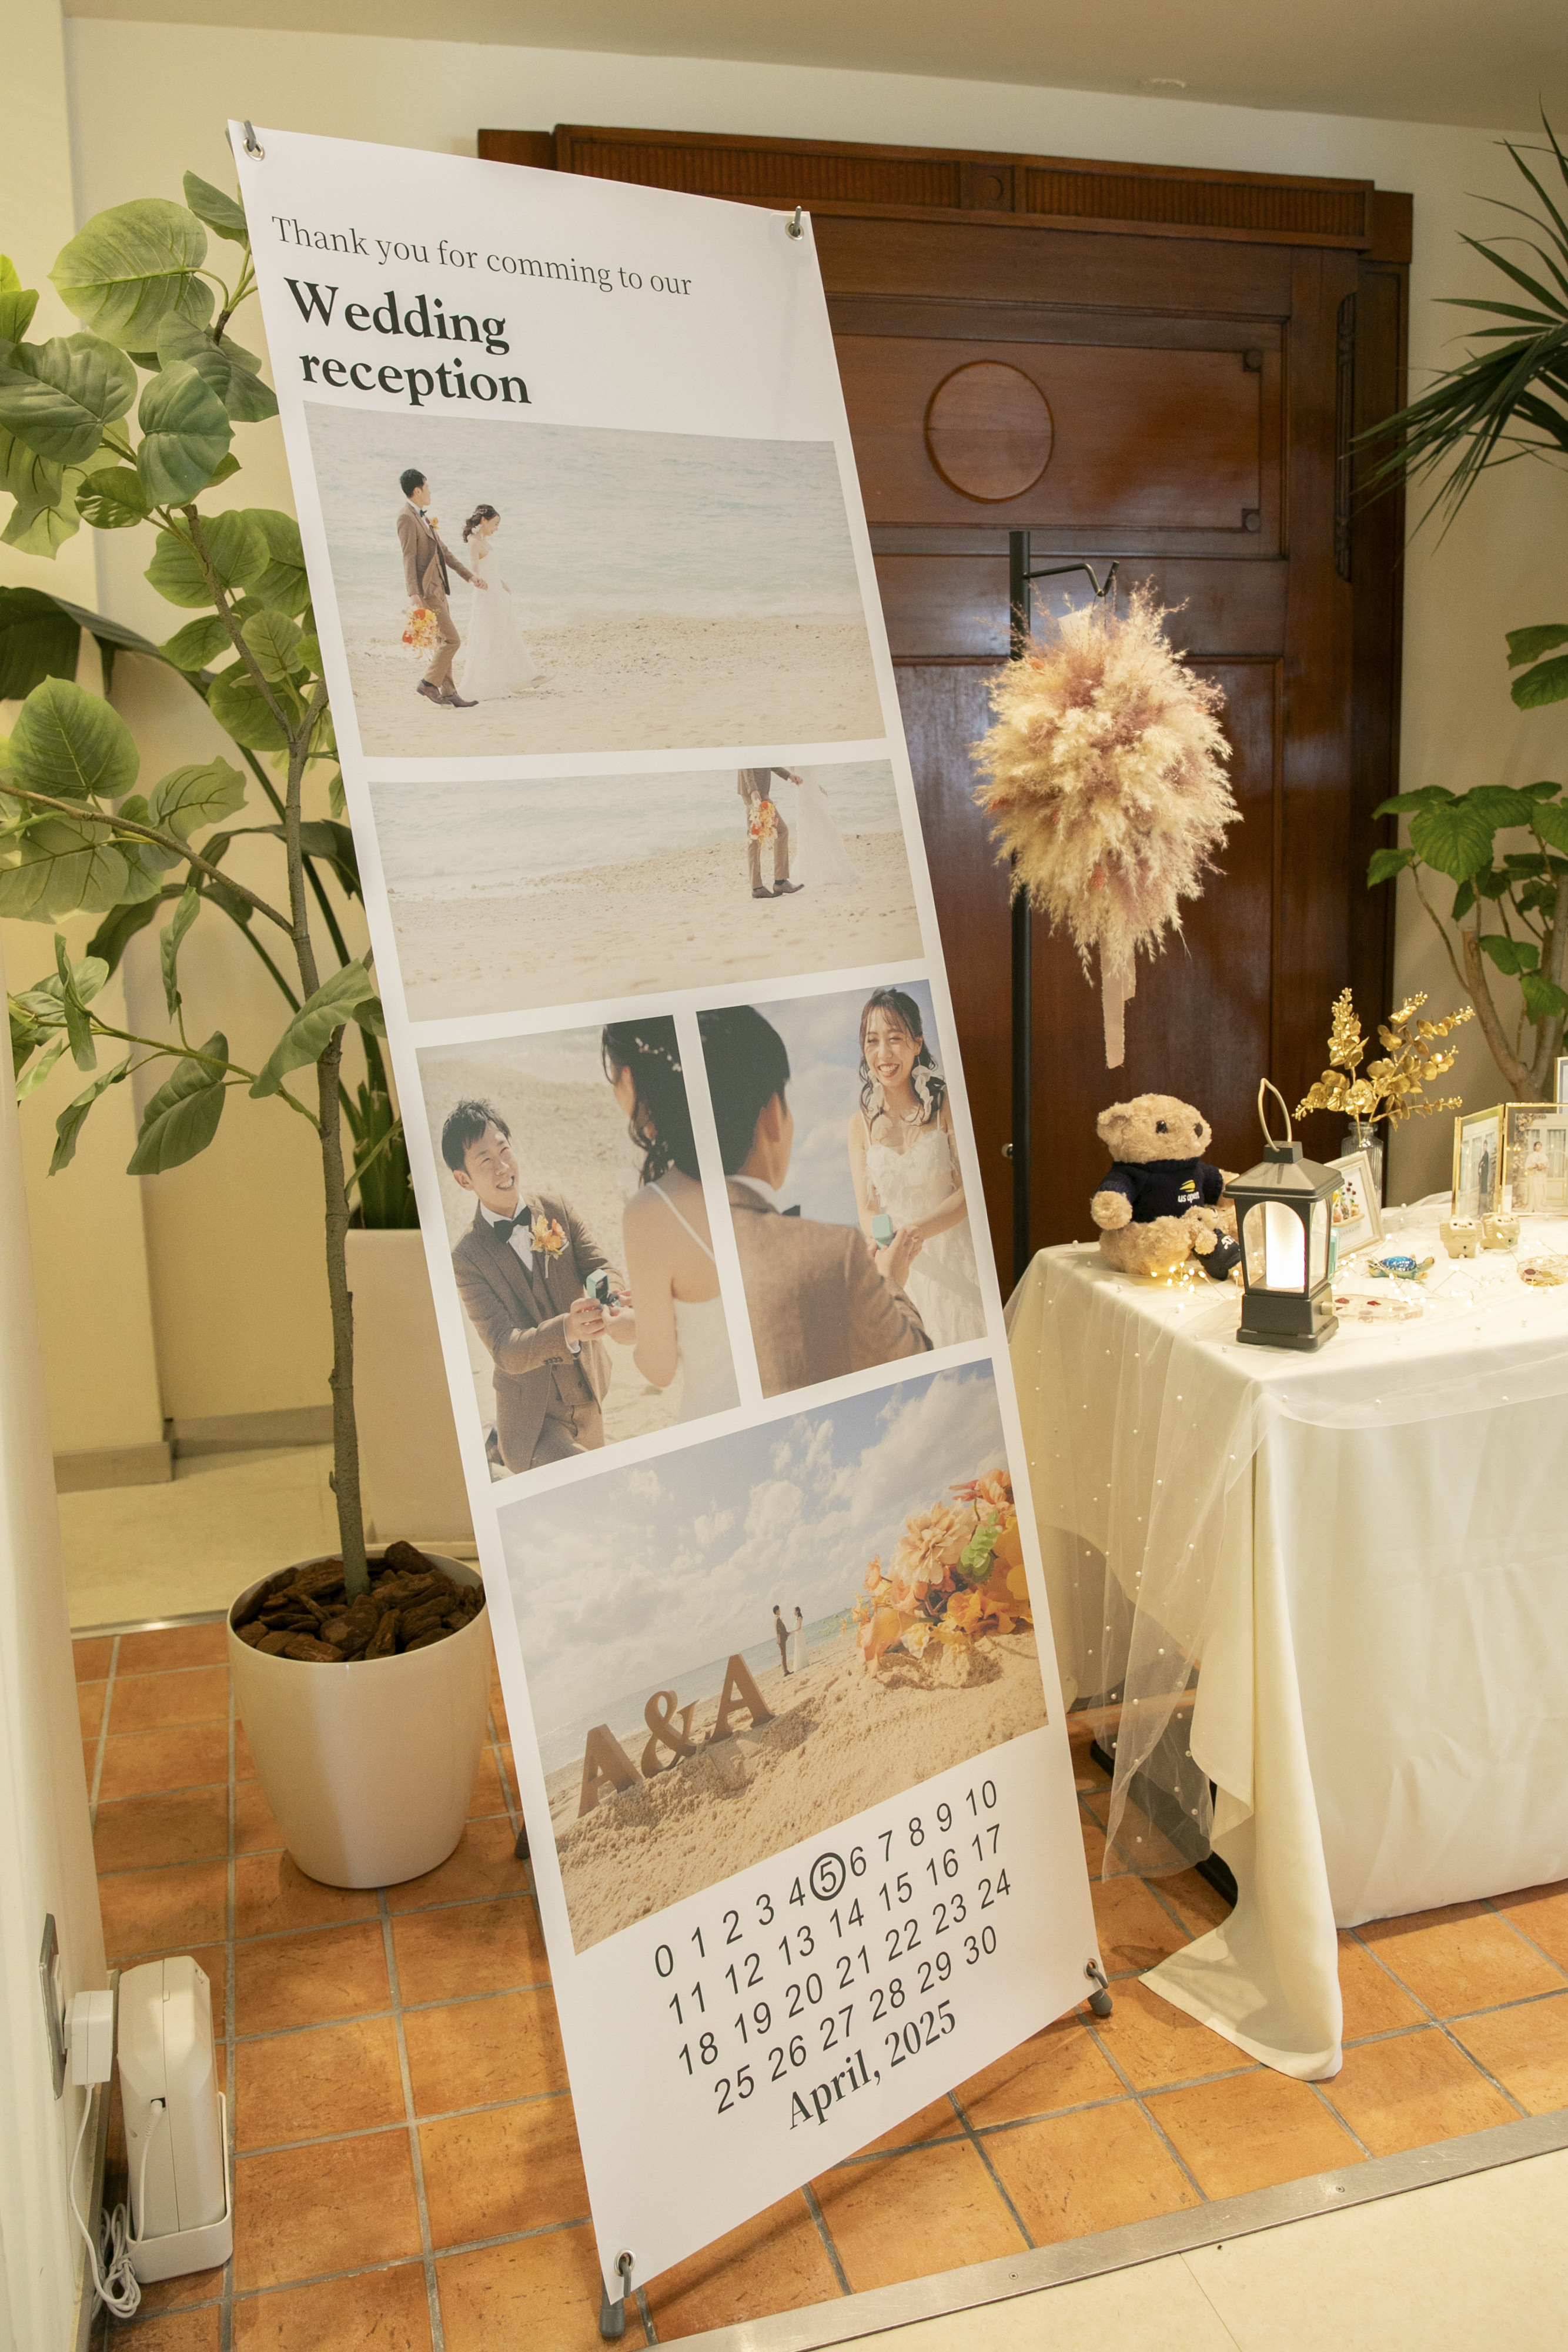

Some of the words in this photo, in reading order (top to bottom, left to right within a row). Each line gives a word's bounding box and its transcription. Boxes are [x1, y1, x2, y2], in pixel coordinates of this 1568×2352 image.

[272, 215, 370, 256] Thank
[375, 239, 430, 266] you
[437, 240, 478, 270] for
[487, 254, 613, 293] comming
[617, 267, 643, 289] to
[650, 275, 692, 296] our
[283, 278, 510, 356] Wedding
[299, 354, 533, 407] reception
[1178, 1194, 1186, 1203] us
[655, 1945, 673, 1977] 0
[691, 1926, 706, 1958] 1
[723, 1910, 743, 1945] 2
[756, 1894, 774, 1925] 3
[789, 1876, 805, 1907] 4
[850, 1846, 867, 1876] 6
[878, 1830, 892, 1862] 7
[909, 1817, 924, 1846] 8
[937, 1803, 952, 1832] 9
[966, 1780, 997, 1816] 10
[669, 1982, 706, 2024] 11
[725, 1953, 764, 1994] 12
[779, 1926, 814, 1966] 13
[830, 1897, 864, 1938] 14
[879, 1872, 912, 1912] 15
[927, 1849, 958, 1886] 16
[972, 1823, 1000, 1862] 17
[678, 2032, 718, 2076] 18
[734, 2002, 771, 2044] 19
[785, 1973, 823, 2019] 20
[836, 1945, 870, 1989] 21
[885, 1919, 921, 1962] 22
[932, 1894, 967, 1935] 23
[978, 1868, 1011, 1910] 24
[714, 2064, 755, 2115] 25
[768, 2035, 807, 2083] 26
[820, 2004, 854, 2052] 27
[870, 1978, 905, 2022] 28
[918, 1952, 952, 1994] 29
[964, 1926, 997, 1965] 30
[790, 2049, 881, 2130] April,
[884, 1999, 956, 2068] 2025
